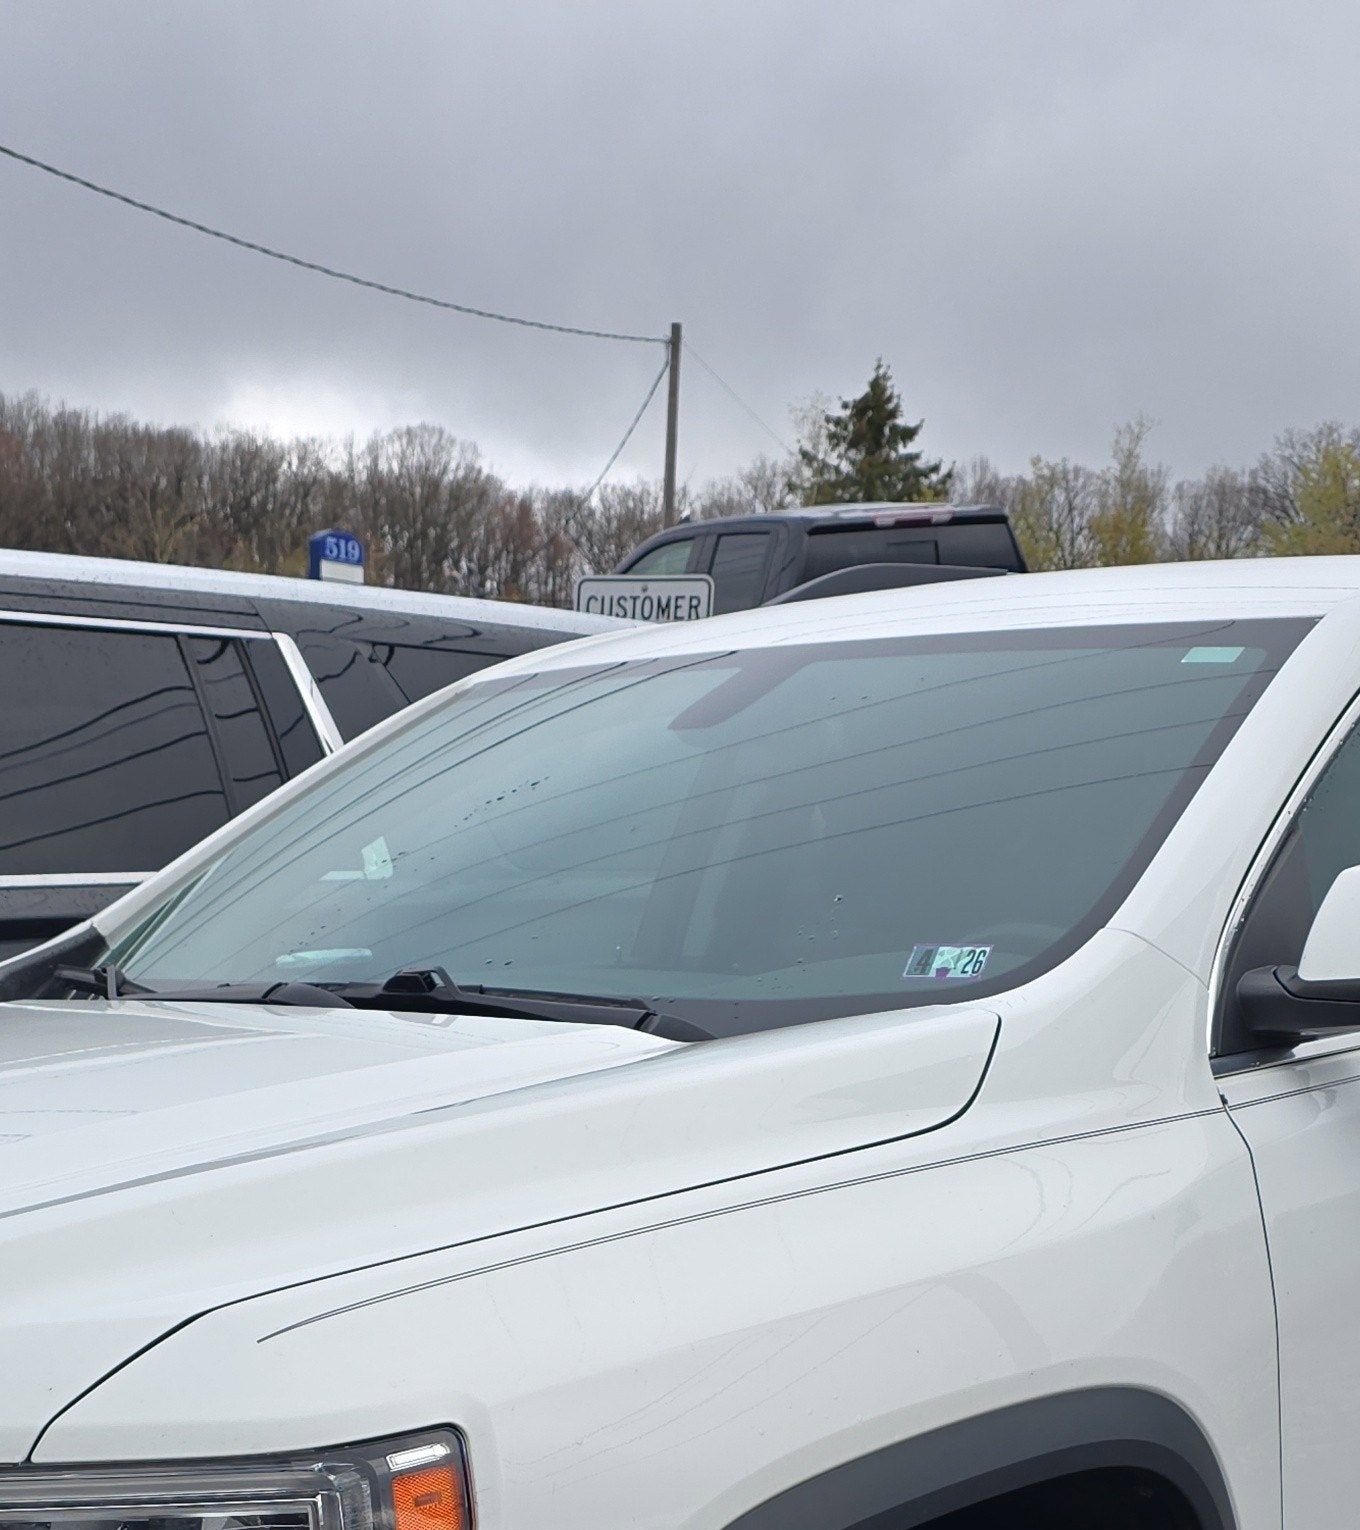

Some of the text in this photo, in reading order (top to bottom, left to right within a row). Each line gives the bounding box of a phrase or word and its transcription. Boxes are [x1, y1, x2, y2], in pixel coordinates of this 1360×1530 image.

[325, 535, 361, 562] 519
[585, 594, 701, 620] CUSTOMER
[961, 949, 987, 975] 26
